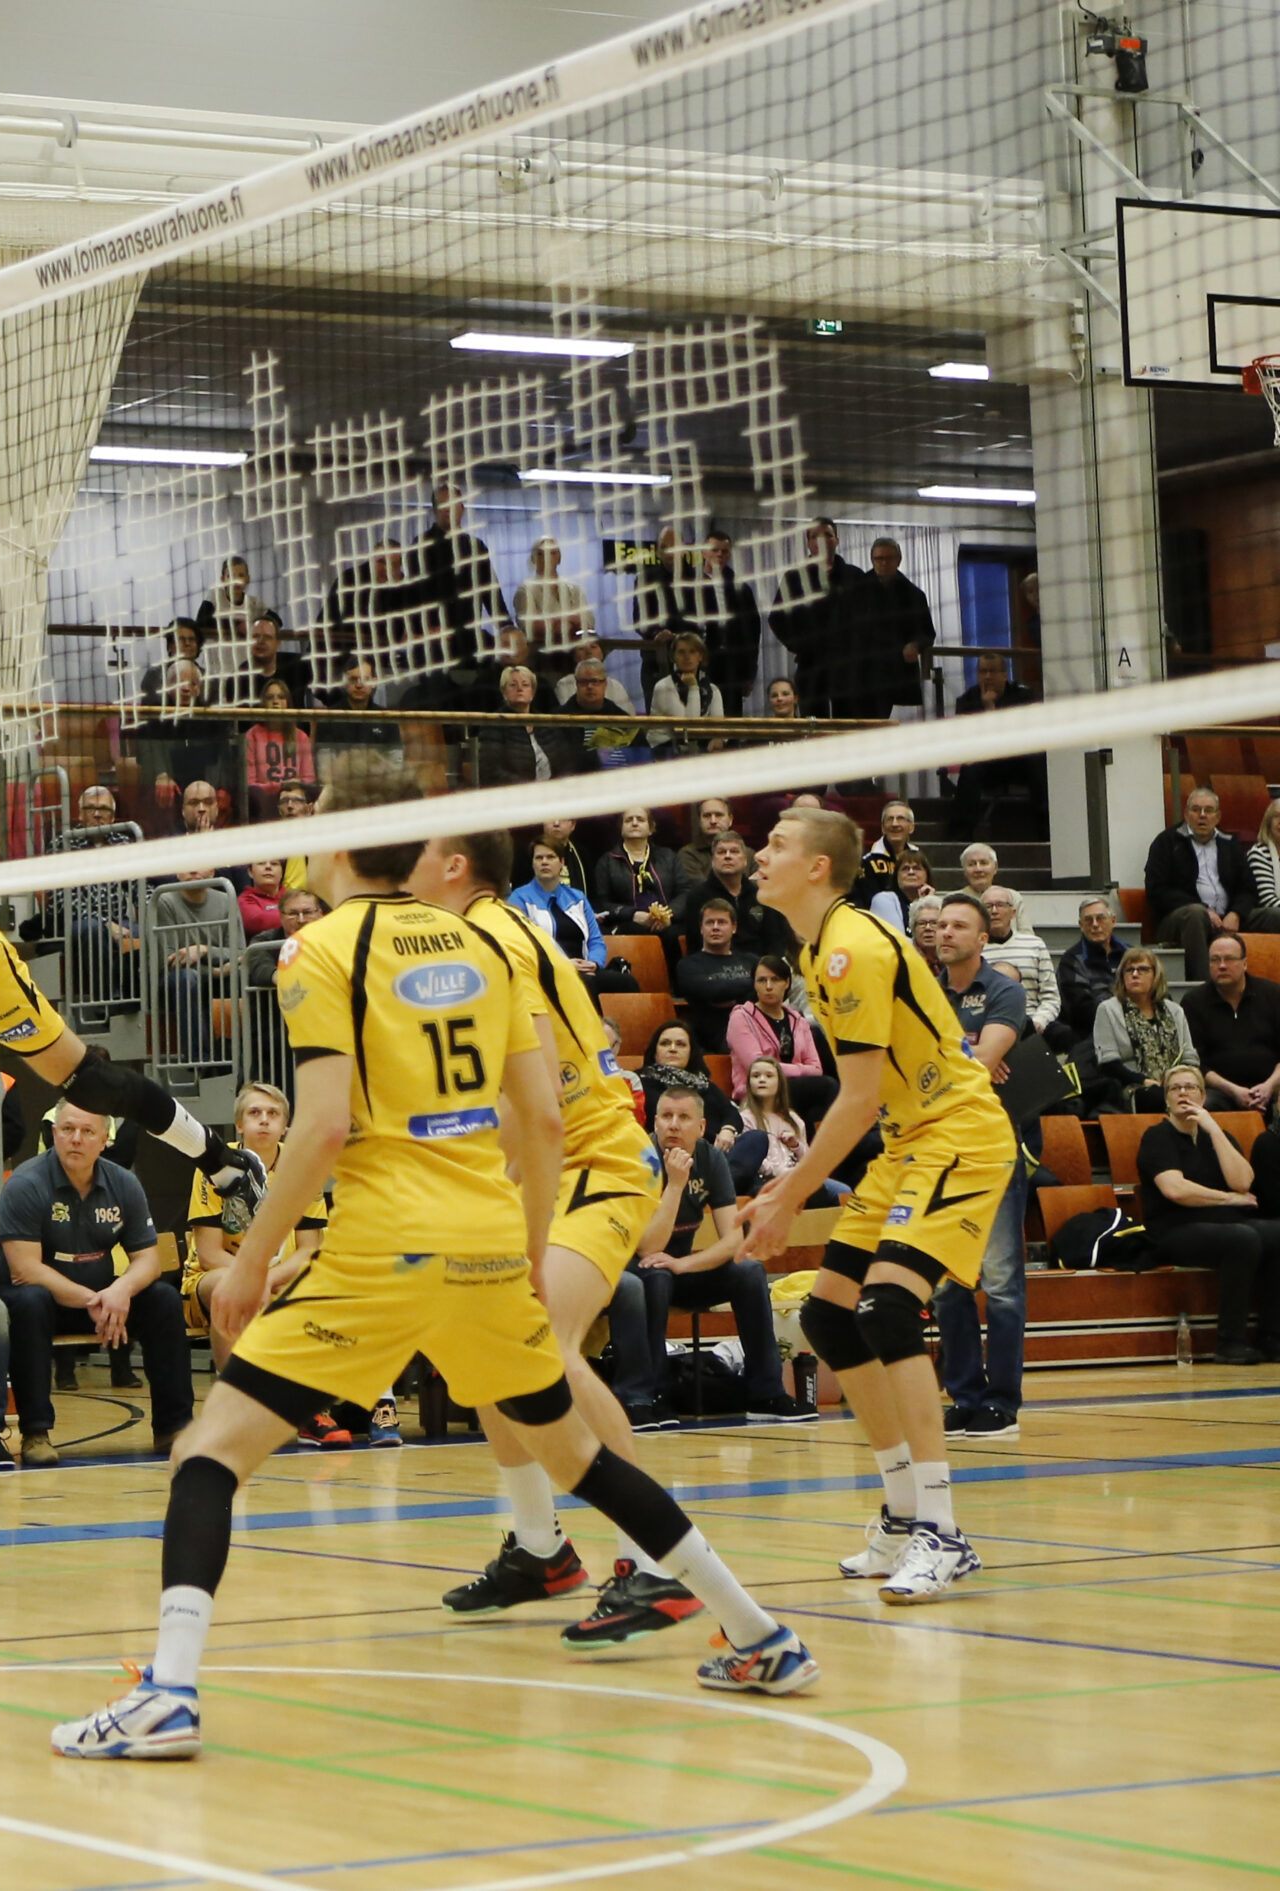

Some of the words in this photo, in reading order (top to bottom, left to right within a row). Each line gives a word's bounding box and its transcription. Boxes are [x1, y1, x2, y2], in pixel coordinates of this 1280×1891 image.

[305, 65, 562, 192] www.loimaanseurahuone.fi
[36, 185, 245, 290] www.loimaanseurahuone.fi
[1118, 646, 1131, 668] A
[393, 931, 465, 956] OIVANEN
[418, 1014, 487, 1099] 15
[94, 1206, 121, 1224] 1962
